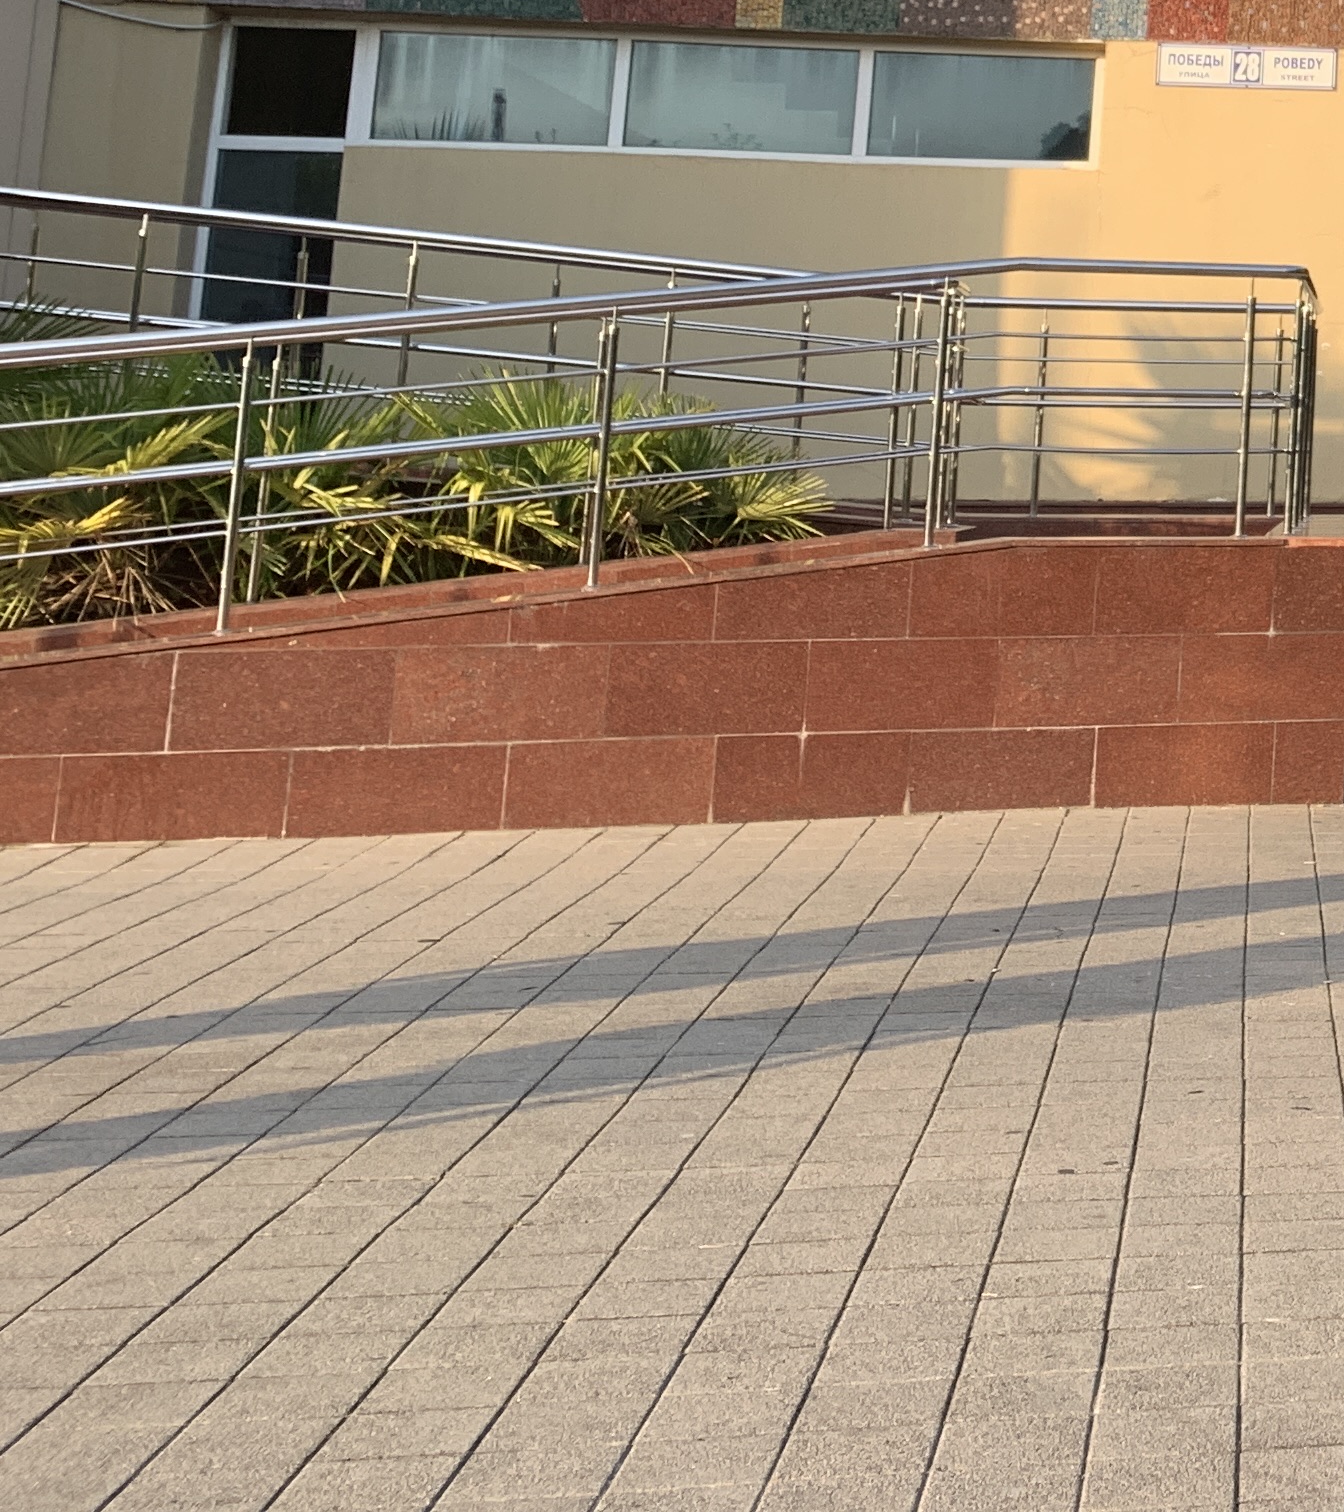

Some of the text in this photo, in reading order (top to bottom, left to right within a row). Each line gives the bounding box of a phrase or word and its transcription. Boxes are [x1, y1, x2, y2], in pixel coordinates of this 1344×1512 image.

[1168, 53, 1224, 68] ПОБЕДЫ
[1234, 52, 1261, 82] 28
[1273, 57, 1324, 70] POBEDY
[1178, 71, 1210, 79] УЛИЦА
[1280, 74, 1315, 82] STREET
